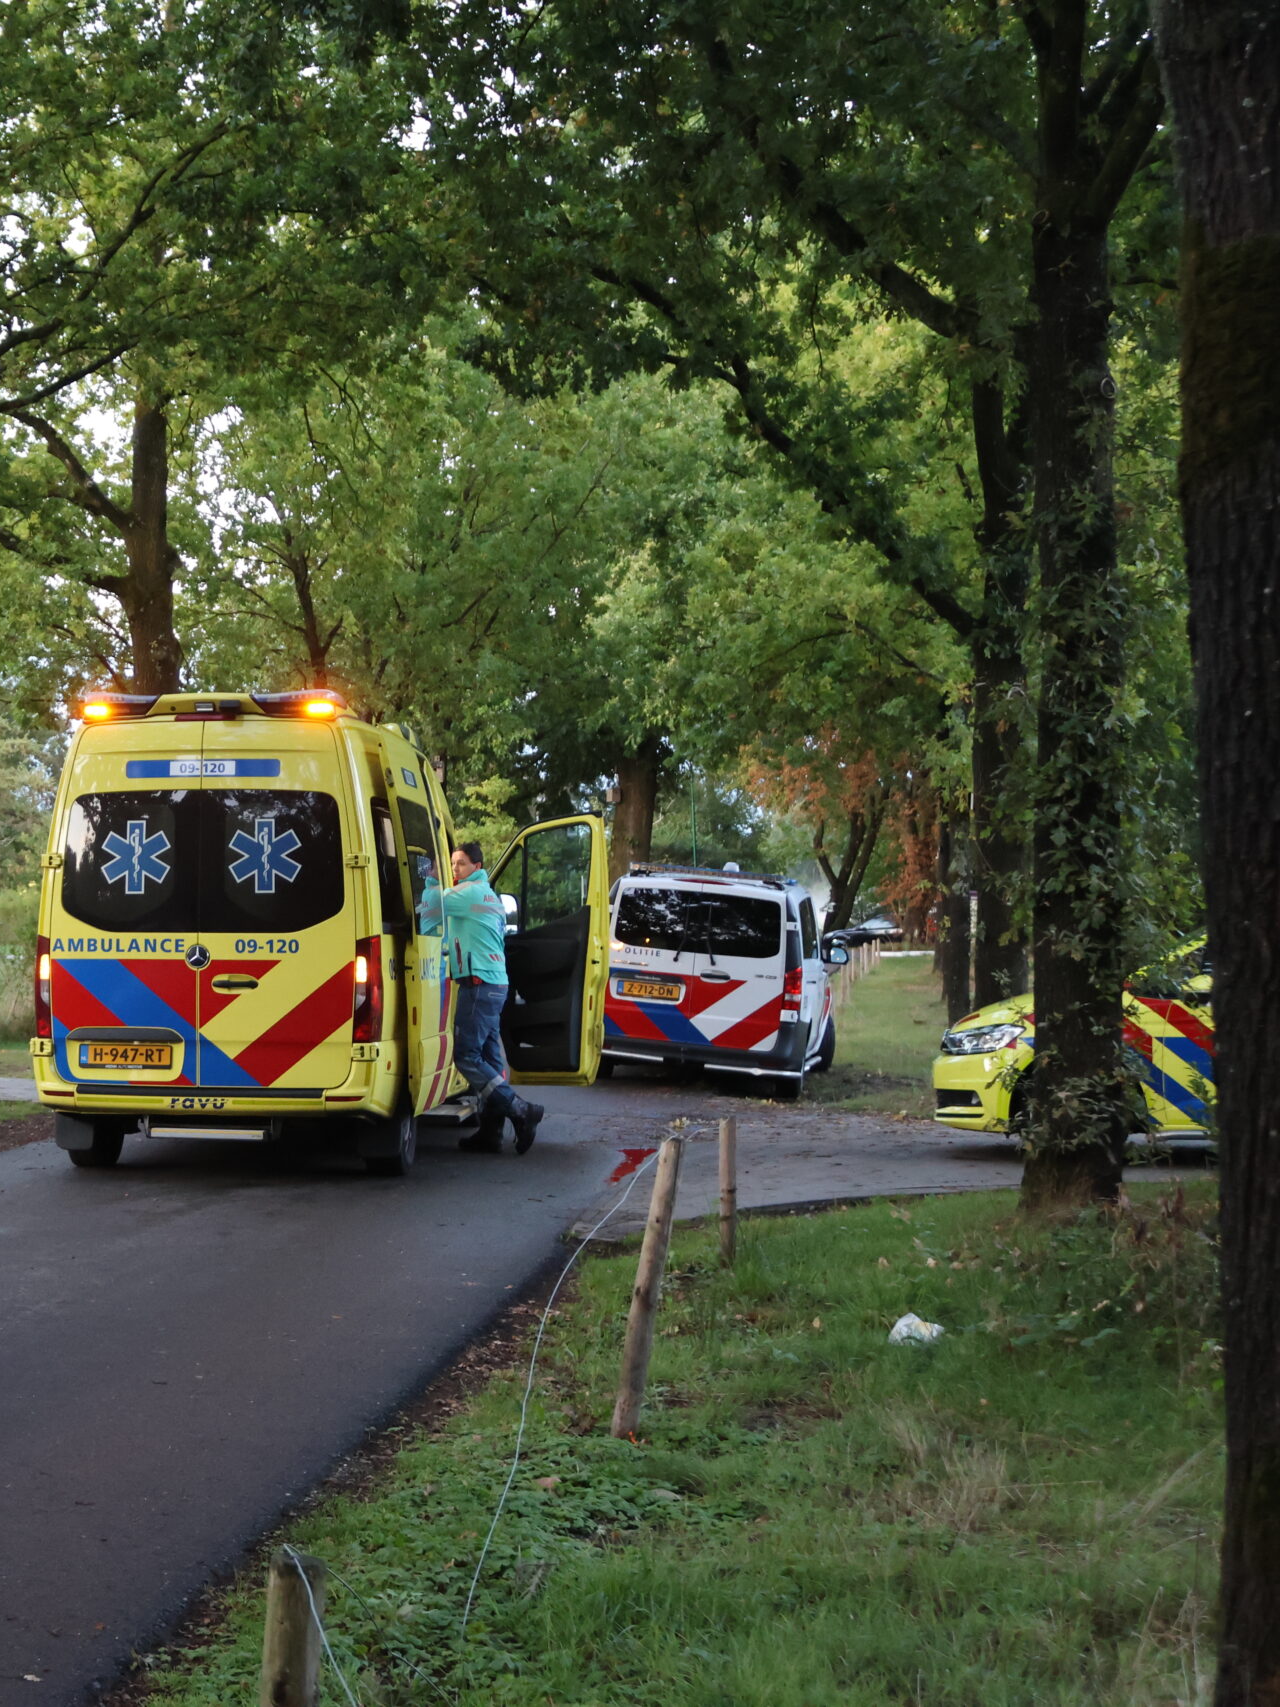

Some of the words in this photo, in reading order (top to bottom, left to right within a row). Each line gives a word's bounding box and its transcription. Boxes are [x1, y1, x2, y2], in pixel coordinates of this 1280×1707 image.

[179, 763, 226, 773] 09-120
[52, 938, 185, 953] AMBULANCE
[235, 939, 300, 953] 09-120
[617, 946, 661, 957] OLITIE
[627, 983, 674, 996] Z-712-DN
[93, 1048, 165, 1062] H-947-RT
